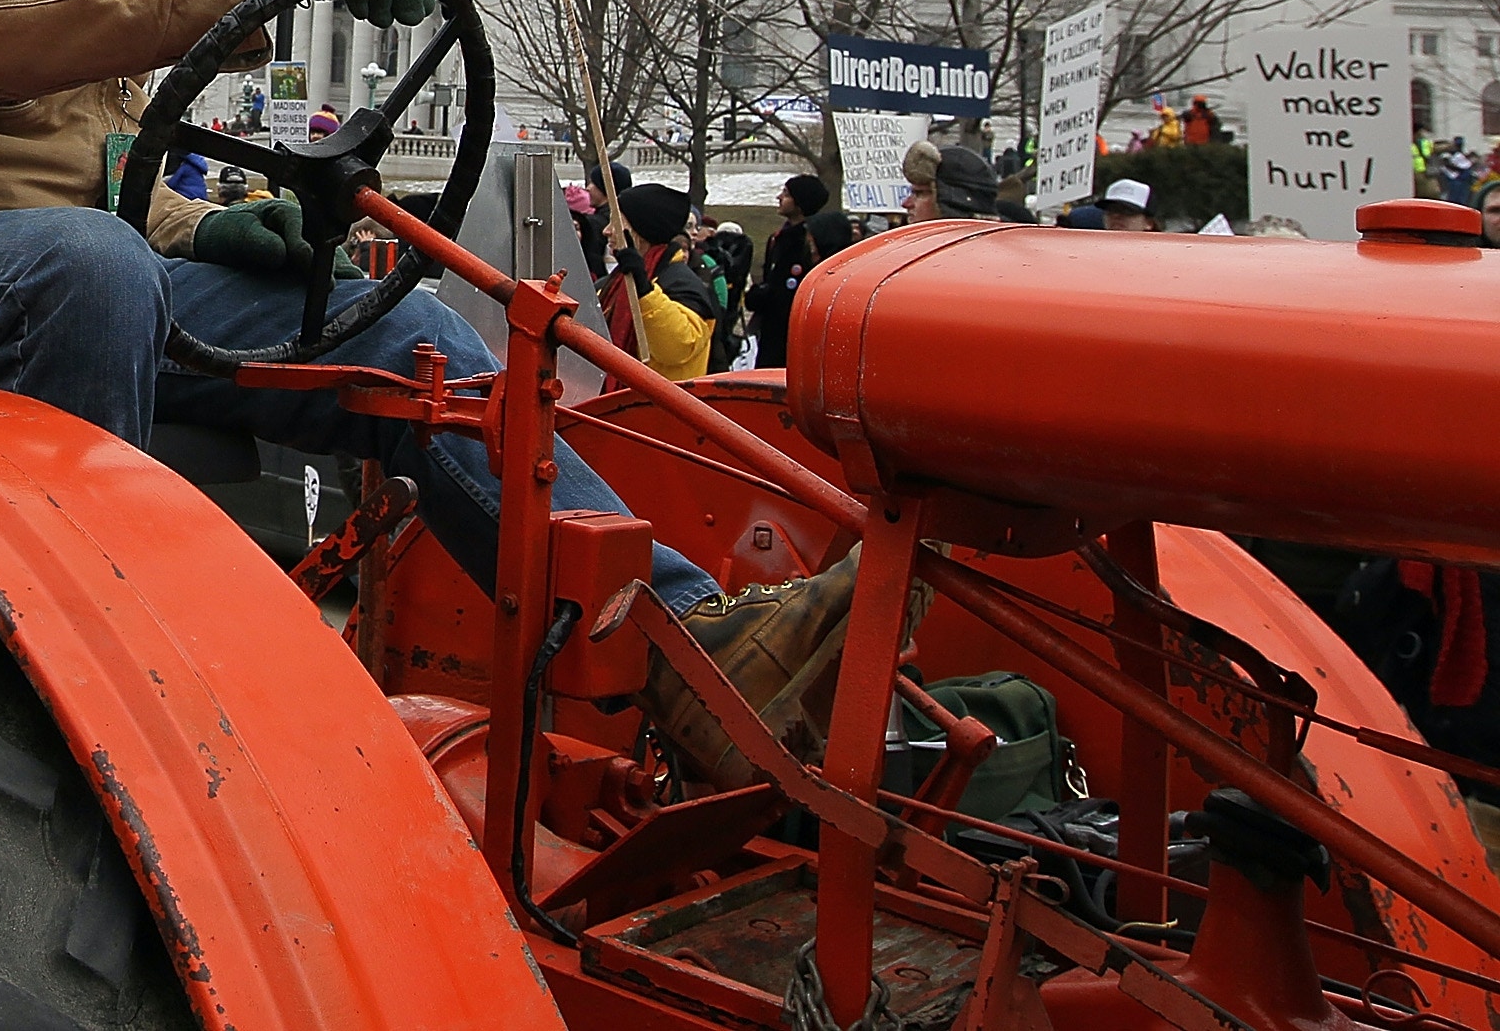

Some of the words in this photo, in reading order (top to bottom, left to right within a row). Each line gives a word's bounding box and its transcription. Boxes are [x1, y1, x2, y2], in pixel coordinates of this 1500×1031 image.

[565, 0, 582, 58] SILENCED
[1091, 13, 1102, 28] UP
[1046, 52, 1059, 67] MY
[1062, 34, 1102, 63] COLLECTIVE
[830, 48, 989, 99] DirectRep.info
[1256, 47, 1389, 82] Walker
[1049, 61, 1099, 92] BARGAINING
[273, 101, 306, 111] MADISON
[1044, 97, 1068, 117] WHEN
[1282, 90, 1382, 116] makes
[273, 113, 307, 124] BUSINESS
[835, 117, 869, 134] PALACE
[1054, 108, 1095, 136] MONKEYS
[272, 126, 307, 137] SUPPORTS
[1305, 129, 1354, 148] me
[866, 149, 902, 166] AGENDA
[1040, 147, 1052, 164] FLY
[1055, 138, 1074, 158] OUT
[1077, 133, 1089, 152] OF
[848, 184, 887, 208] RECALL
[1040, 176, 1055, 195] MY
